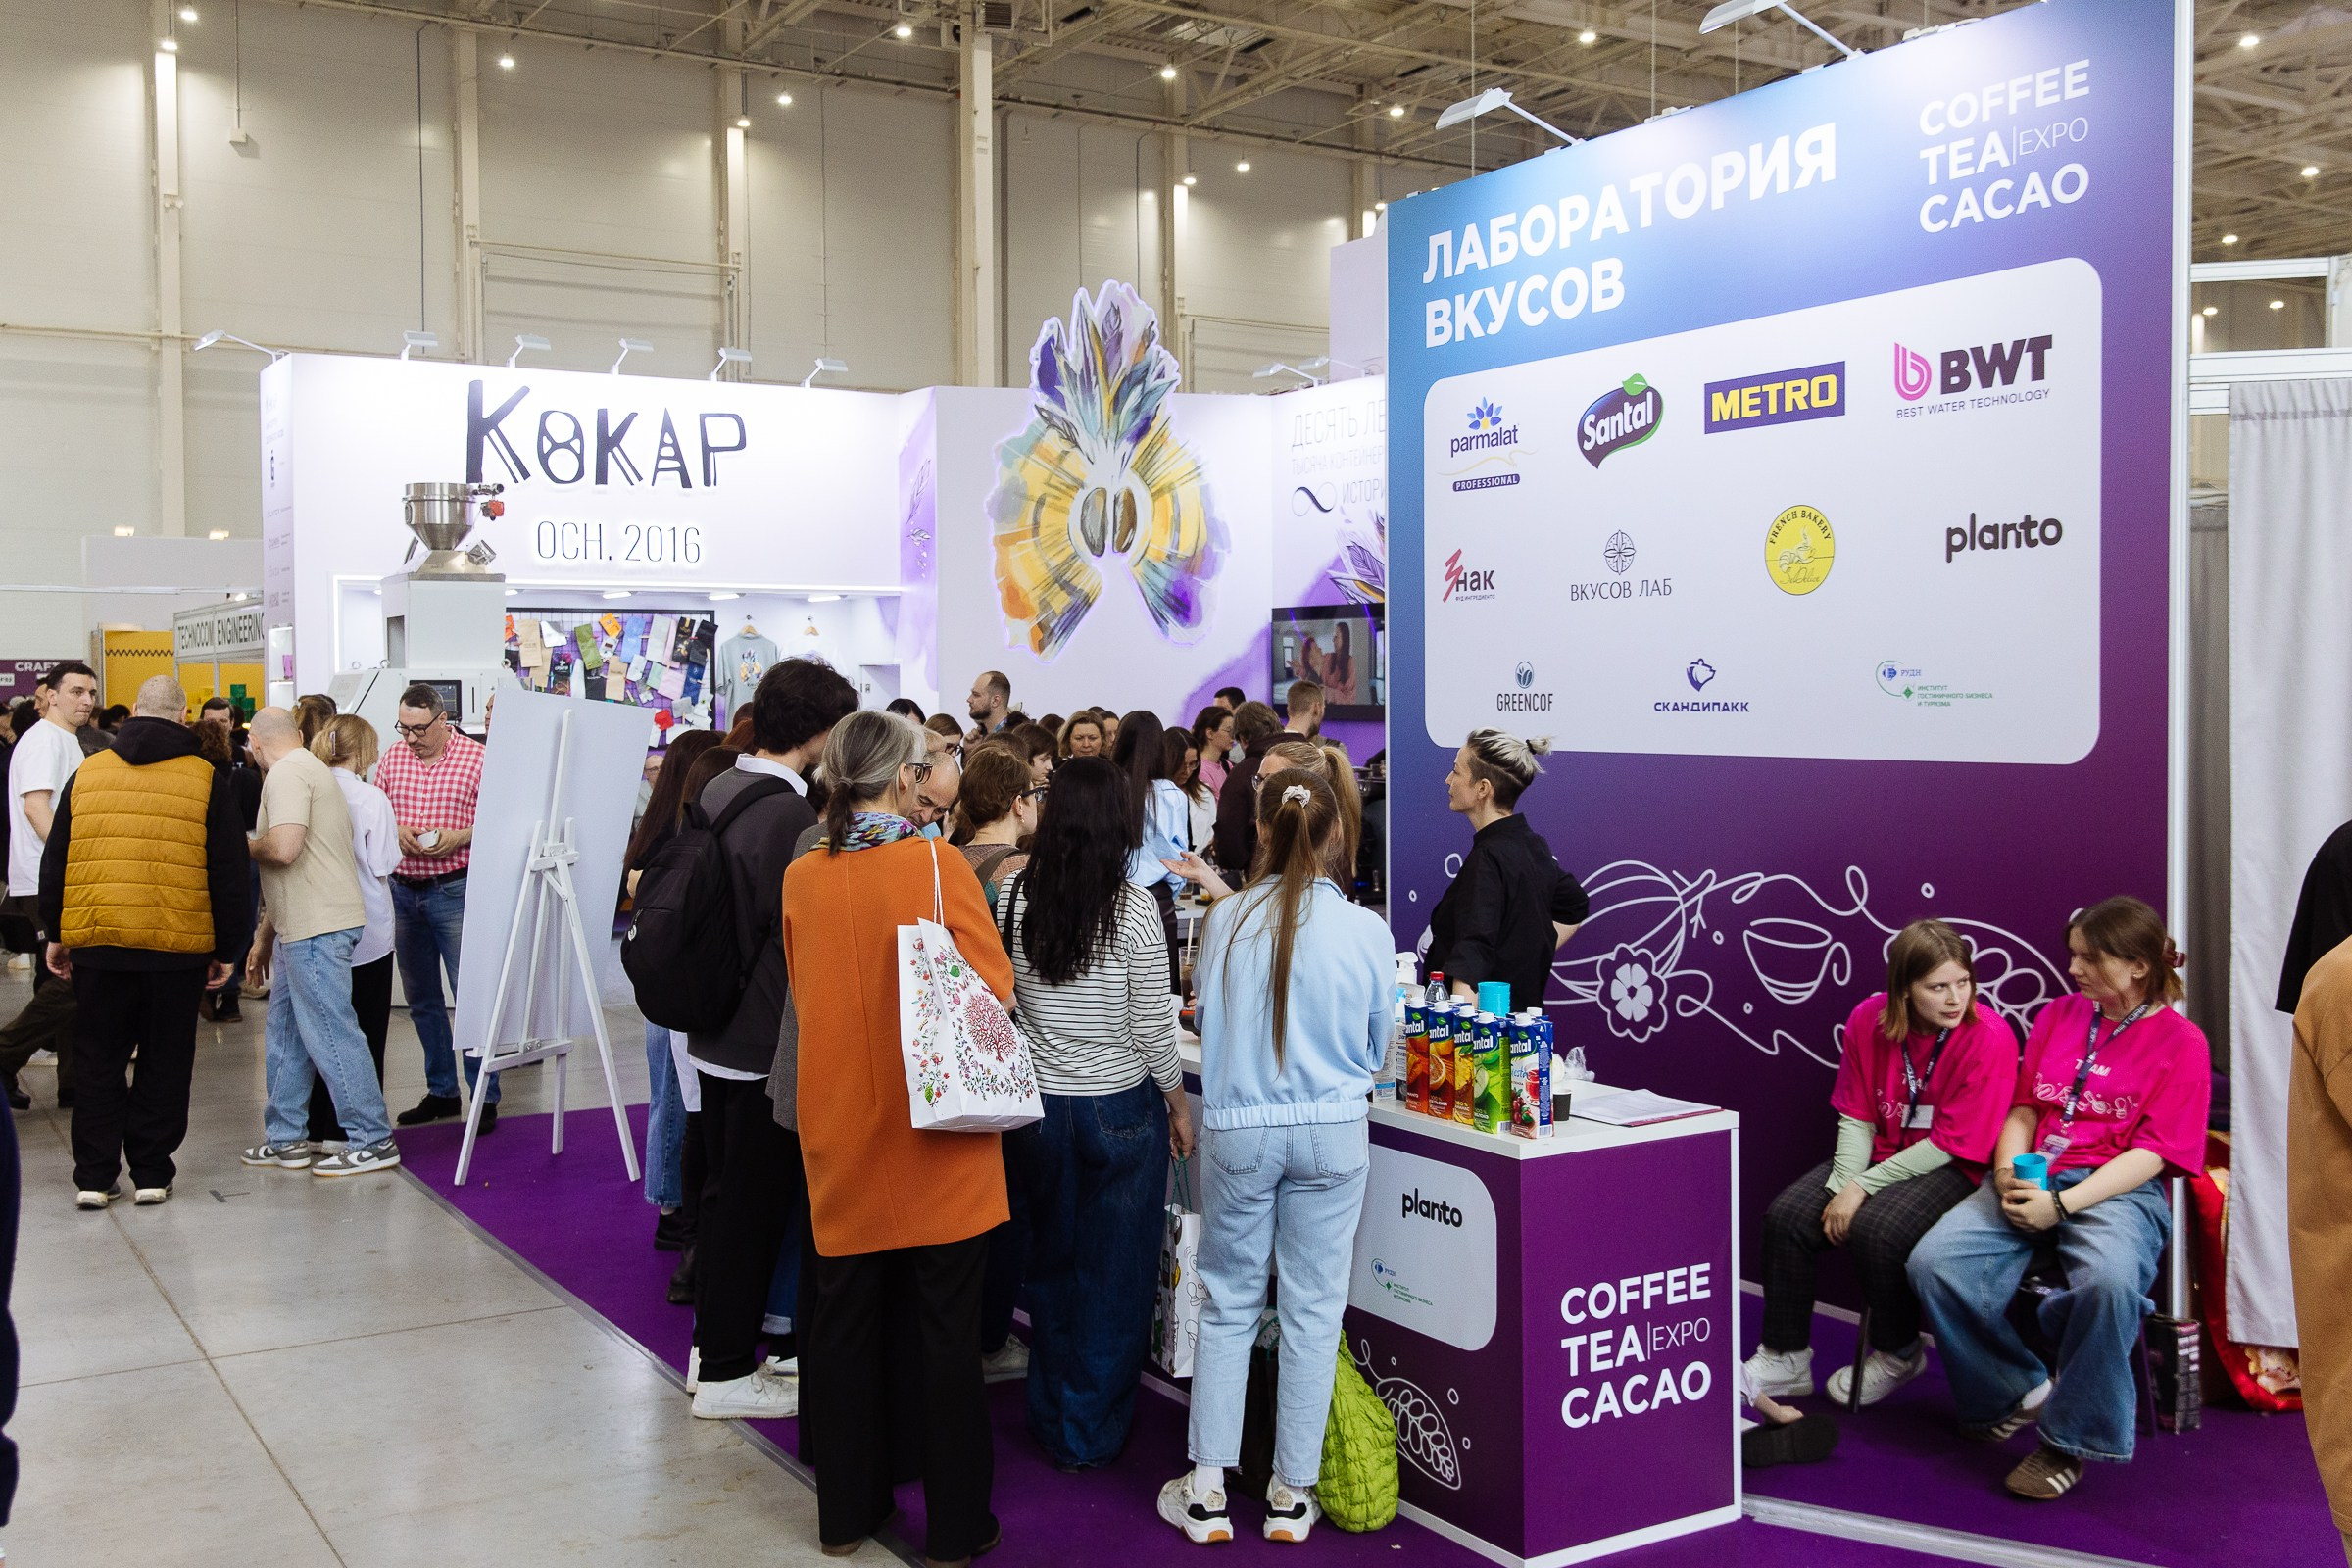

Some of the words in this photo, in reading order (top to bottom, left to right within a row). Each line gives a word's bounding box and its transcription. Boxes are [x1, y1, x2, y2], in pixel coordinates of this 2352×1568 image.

[1919, 59, 2090, 137] COFFEE
[1422, 122, 1837, 285] ЛАБОРАТОРИЯ
[1919, 162, 2090, 234] CACAO
[1425, 257, 1626, 349] ВКУСОВ
[1940, 334, 2053, 395] BWT
[1711, 373, 1838, 423] METRO
[1896, 406, 1924, 418] BEST
[1927, 401, 1966, 414] WATER
[1970, 387, 2051, 410] TECHNOLOGY
[1292, 407, 1358, 452] ДЕСЯТЬ
[1582, 391, 1654, 451] Santal
[1450, 425, 1519, 458] parmalat
[1455, 475, 1518, 491] PROFESSIONAL
[624, 523, 701, 563] 2016
[1769, 510, 1798, 545] FRENCH
[1800, 510, 1832, 540] BAKERY
[1946, 513, 2063, 564] planto
[1570, 582, 1632, 601] ВКУСОВ
[1639, 578, 1673, 597] ЛАБ
[1496, 693, 1553, 711] GREENCOF
[1653, 701, 1750, 712] СКАНДИПАКК
[1405, 1019, 1425, 1034] antal
[1429, 1024, 1449, 1039] antal
[1453, 1030, 1474, 1044] antal
[1473, 1035, 1494, 1050] antal
[1510, 1038, 1532, 1054] antal
[2074, 1059, 2112, 1077] TAM
[1401, 1188, 1463, 1228] planto
[1560, 1262, 1712, 1325] COFFEE
[1561, 1360, 1712, 1429] CACAO
